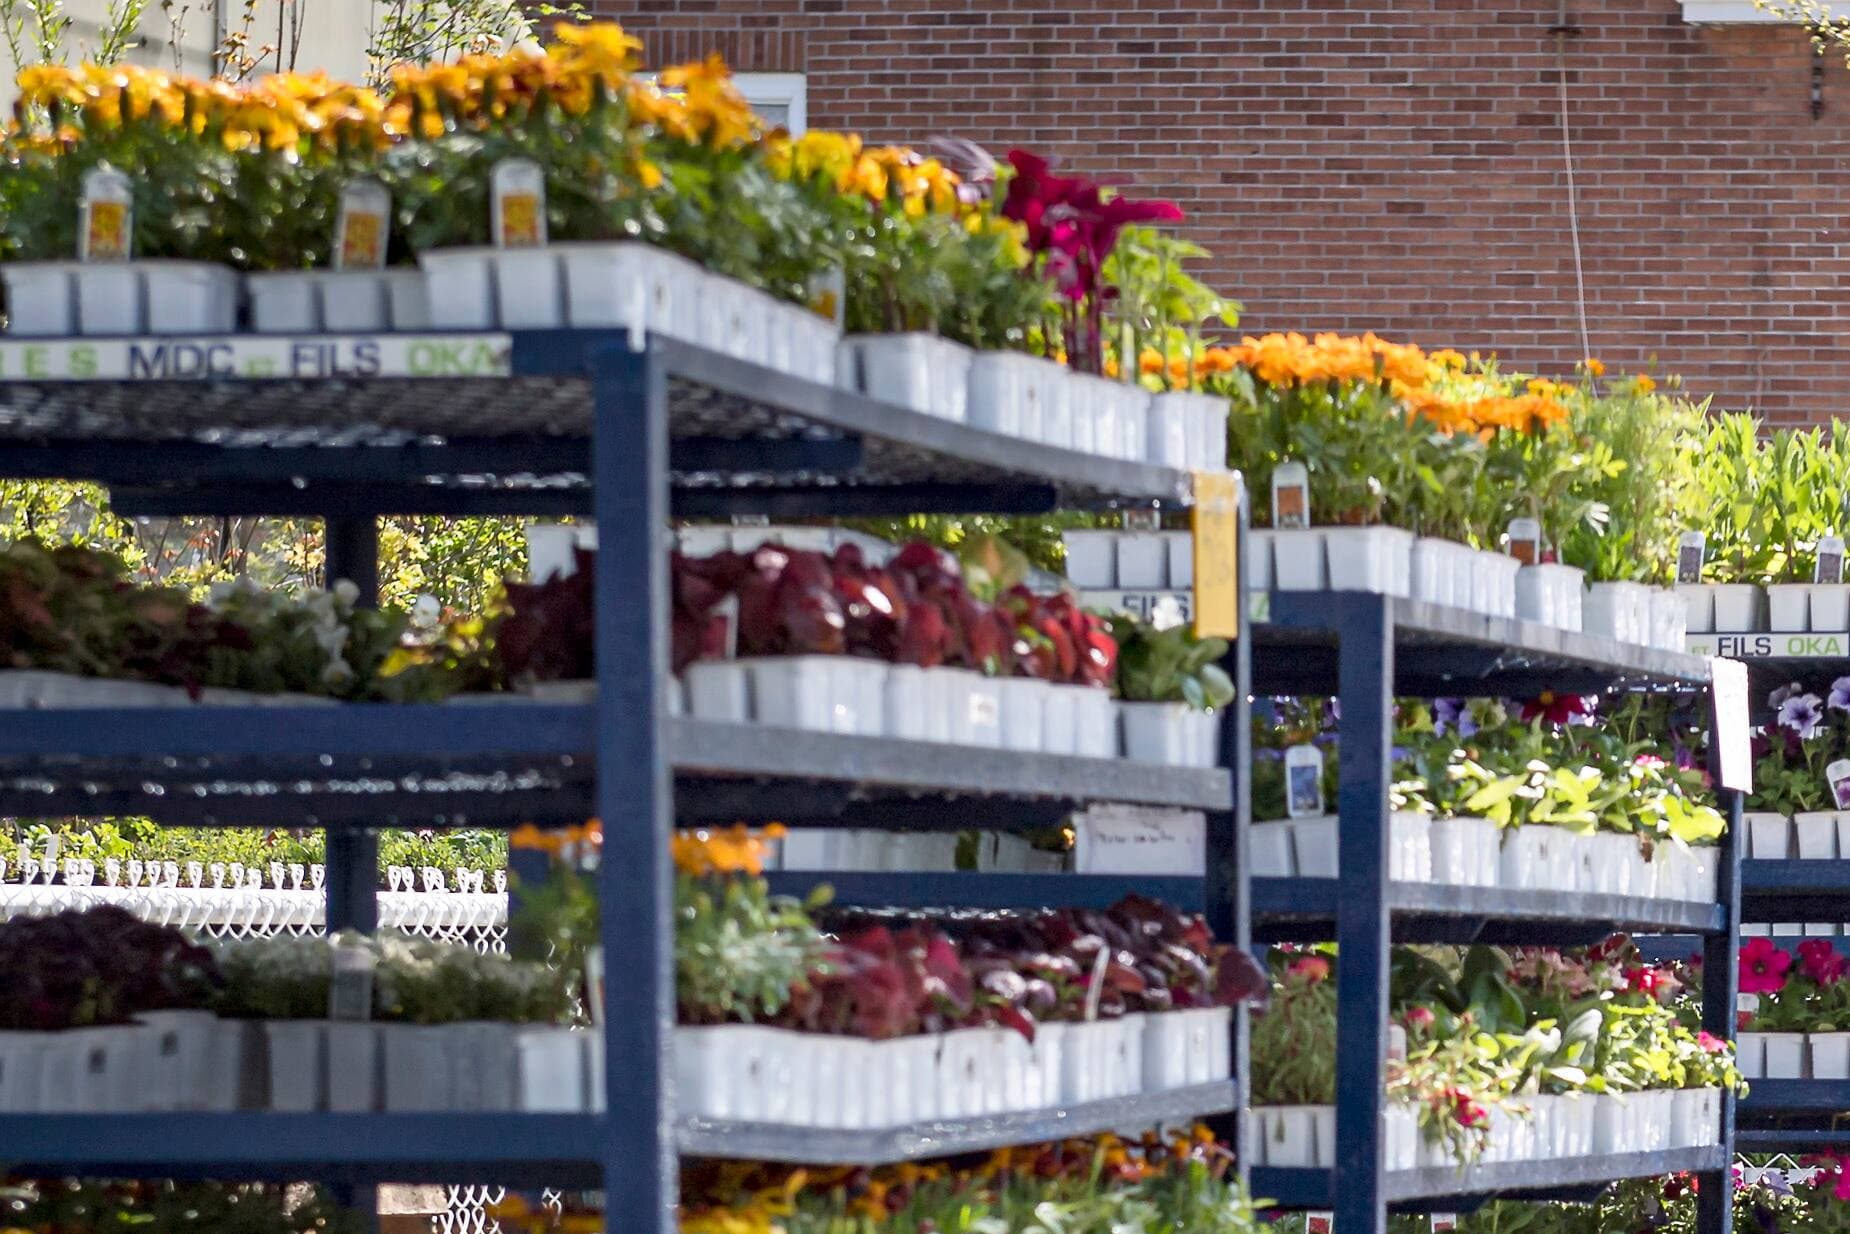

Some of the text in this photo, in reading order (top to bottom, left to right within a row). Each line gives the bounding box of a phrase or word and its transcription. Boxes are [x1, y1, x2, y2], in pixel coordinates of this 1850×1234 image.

[127, 344, 236, 380] MDC
[291, 342, 382, 378] FILS
[407, 340, 504, 377] OKA
[1718, 637, 1771, 657] FILS
[1787, 637, 1840, 656] OKA
